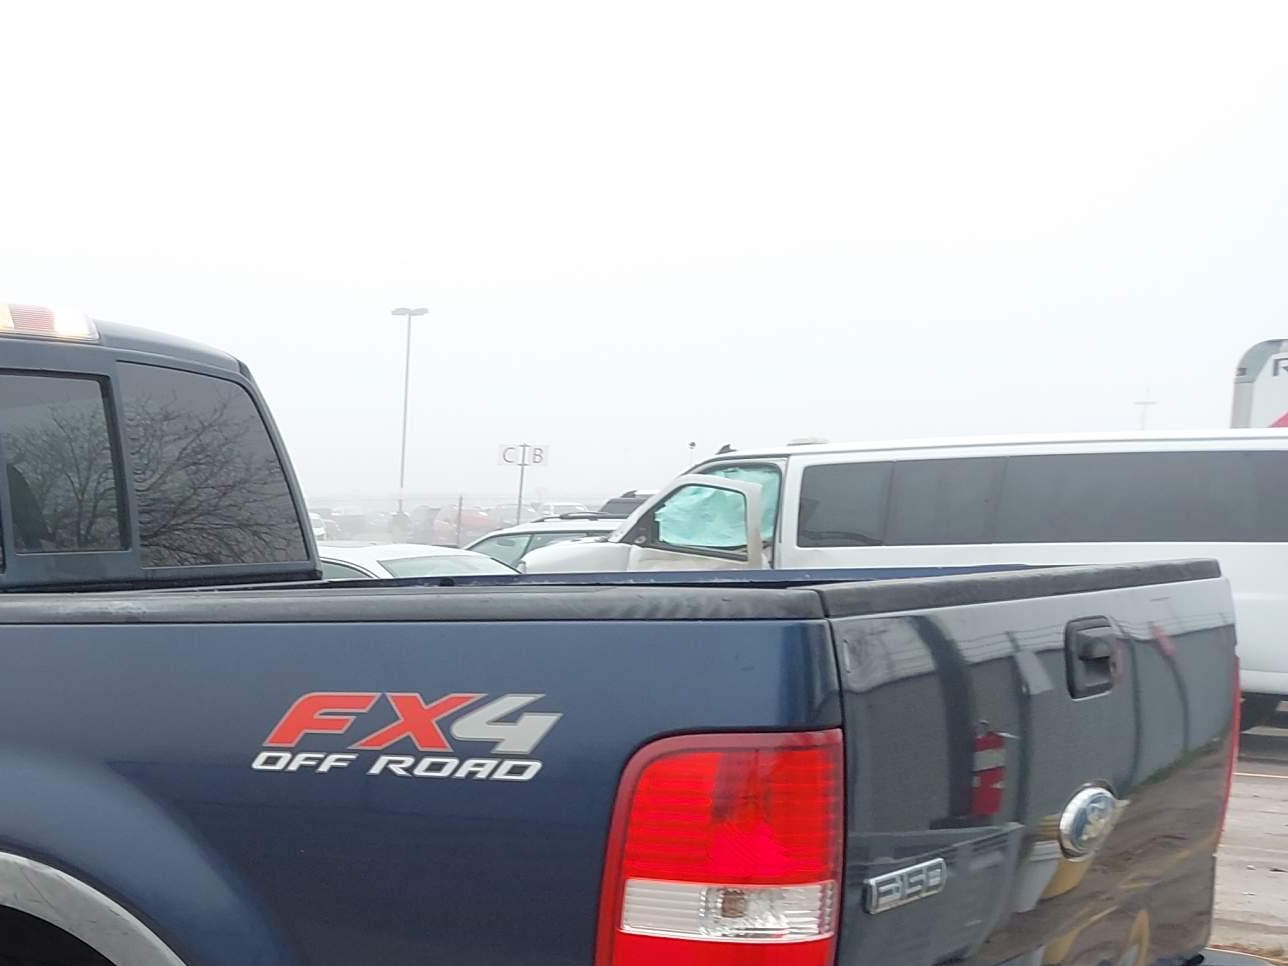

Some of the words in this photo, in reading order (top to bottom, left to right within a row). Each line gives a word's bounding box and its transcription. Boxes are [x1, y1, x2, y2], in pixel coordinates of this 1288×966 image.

[502, 446, 516, 463] C
[532, 447, 544, 464] B
[262, 691, 563, 755] FX4
[251, 750, 359, 773] OFF
[366, 753, 543, 781] ROAD
